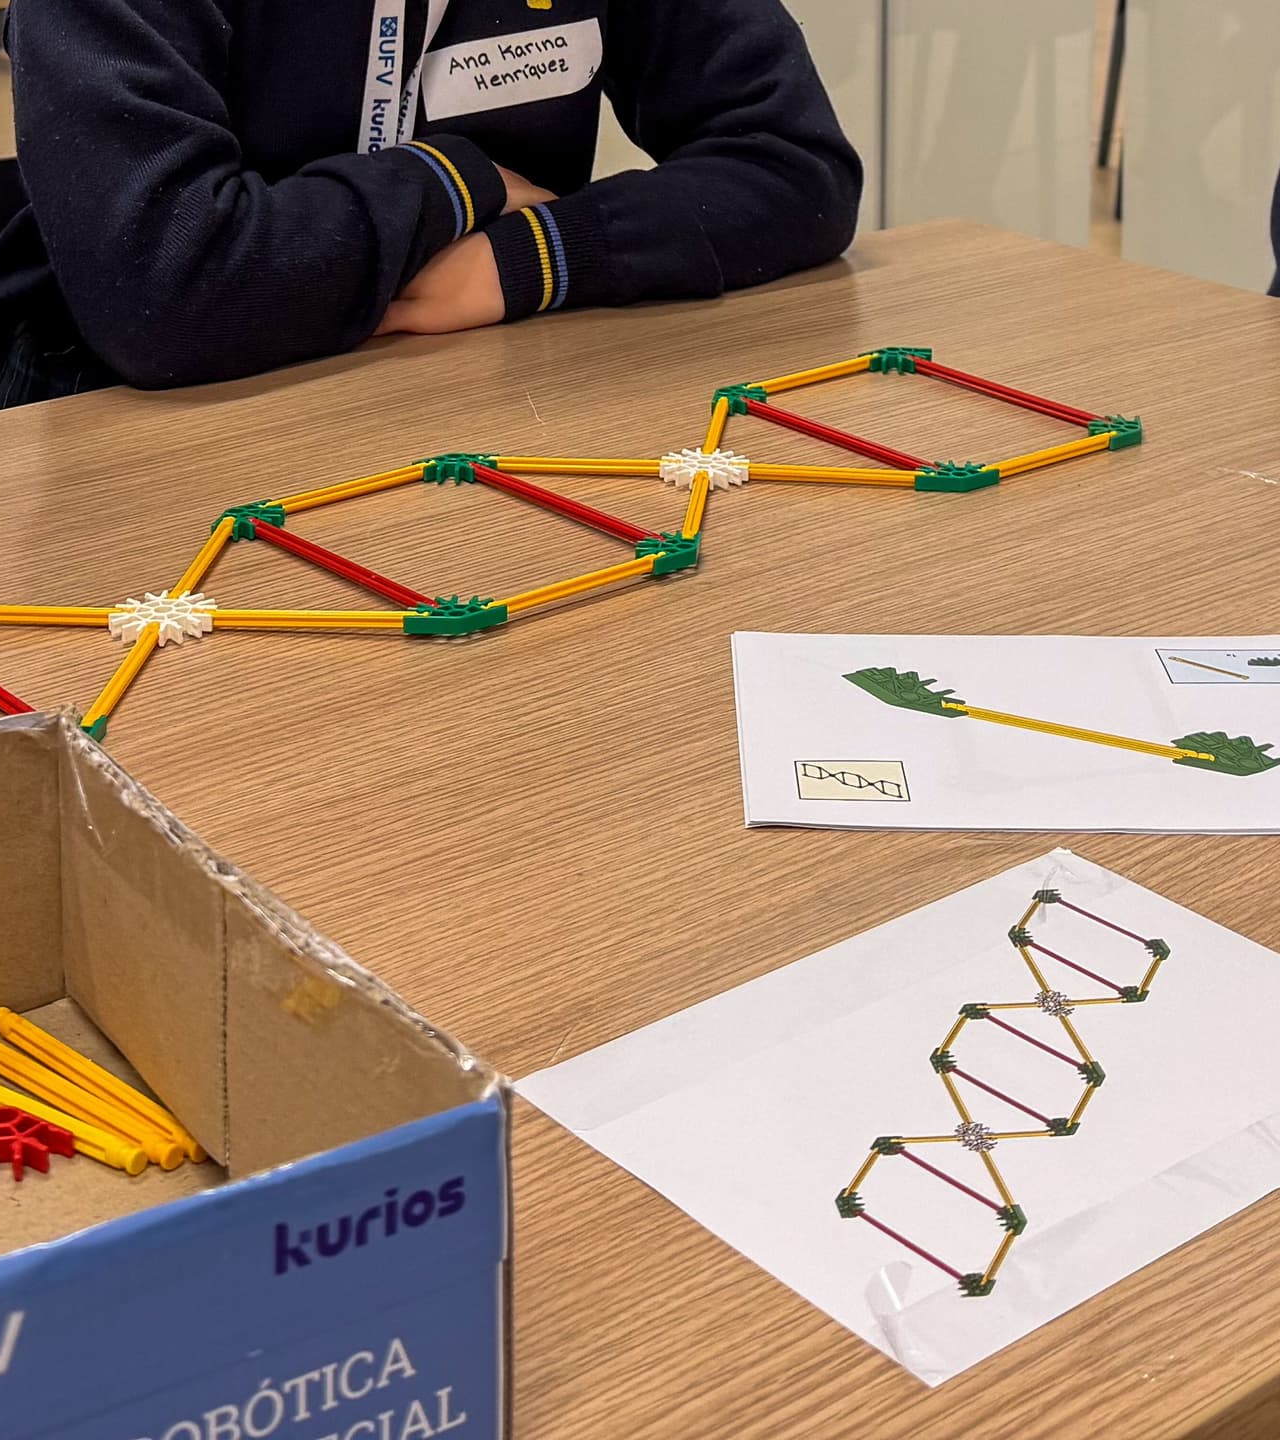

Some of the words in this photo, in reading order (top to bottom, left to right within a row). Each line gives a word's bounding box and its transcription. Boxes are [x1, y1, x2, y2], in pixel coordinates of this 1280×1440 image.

[375, 39, 397, 86] UFV
[449, 52, 491, 75] Ana
[498, 35, 568, 61] Karina
[474, 58, 569, 91] Henríquez
[367, 98, 392, 153] kurio
[271, 1176, 467, 1276] kurios
